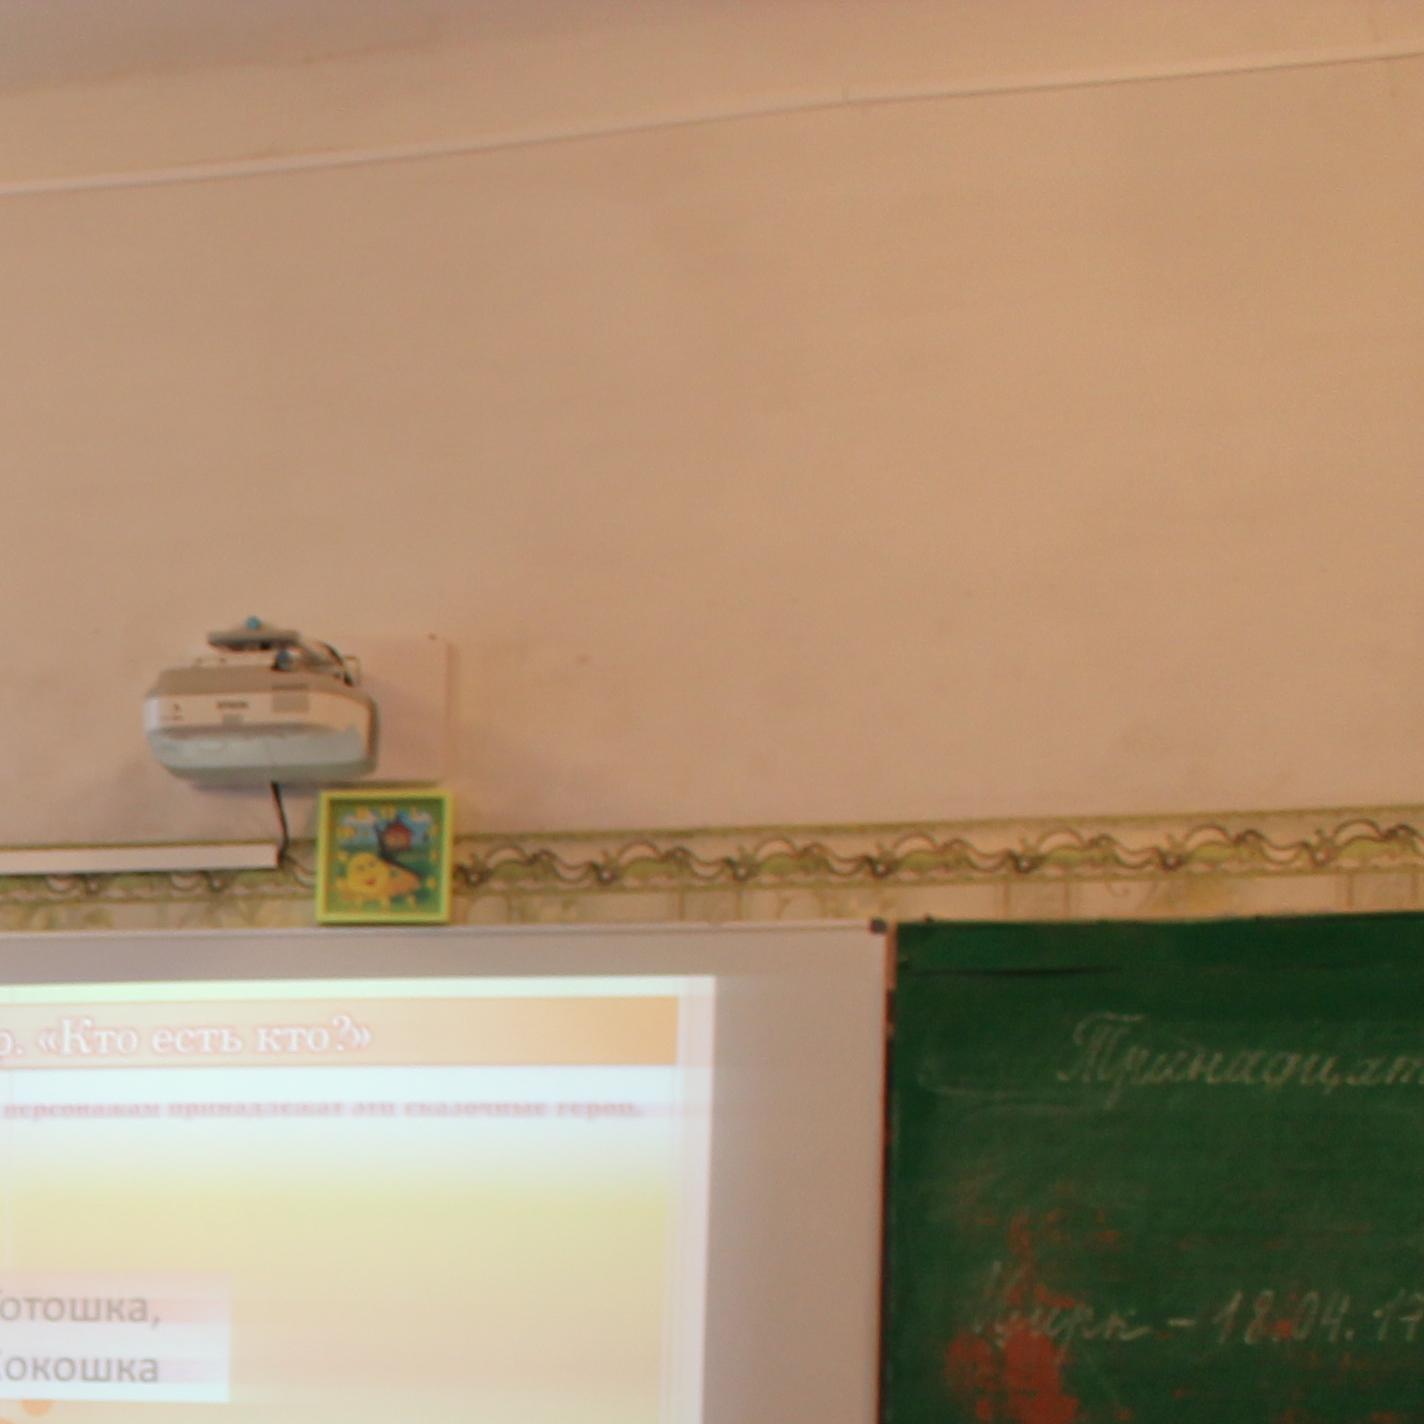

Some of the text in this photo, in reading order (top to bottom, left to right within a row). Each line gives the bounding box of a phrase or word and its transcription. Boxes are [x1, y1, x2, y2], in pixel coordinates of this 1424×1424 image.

[37, 1016, 139, 1056] «Кто
[150, 1024, 243, 1055] есть
[255, 1014, 373, 1053] кто?»
